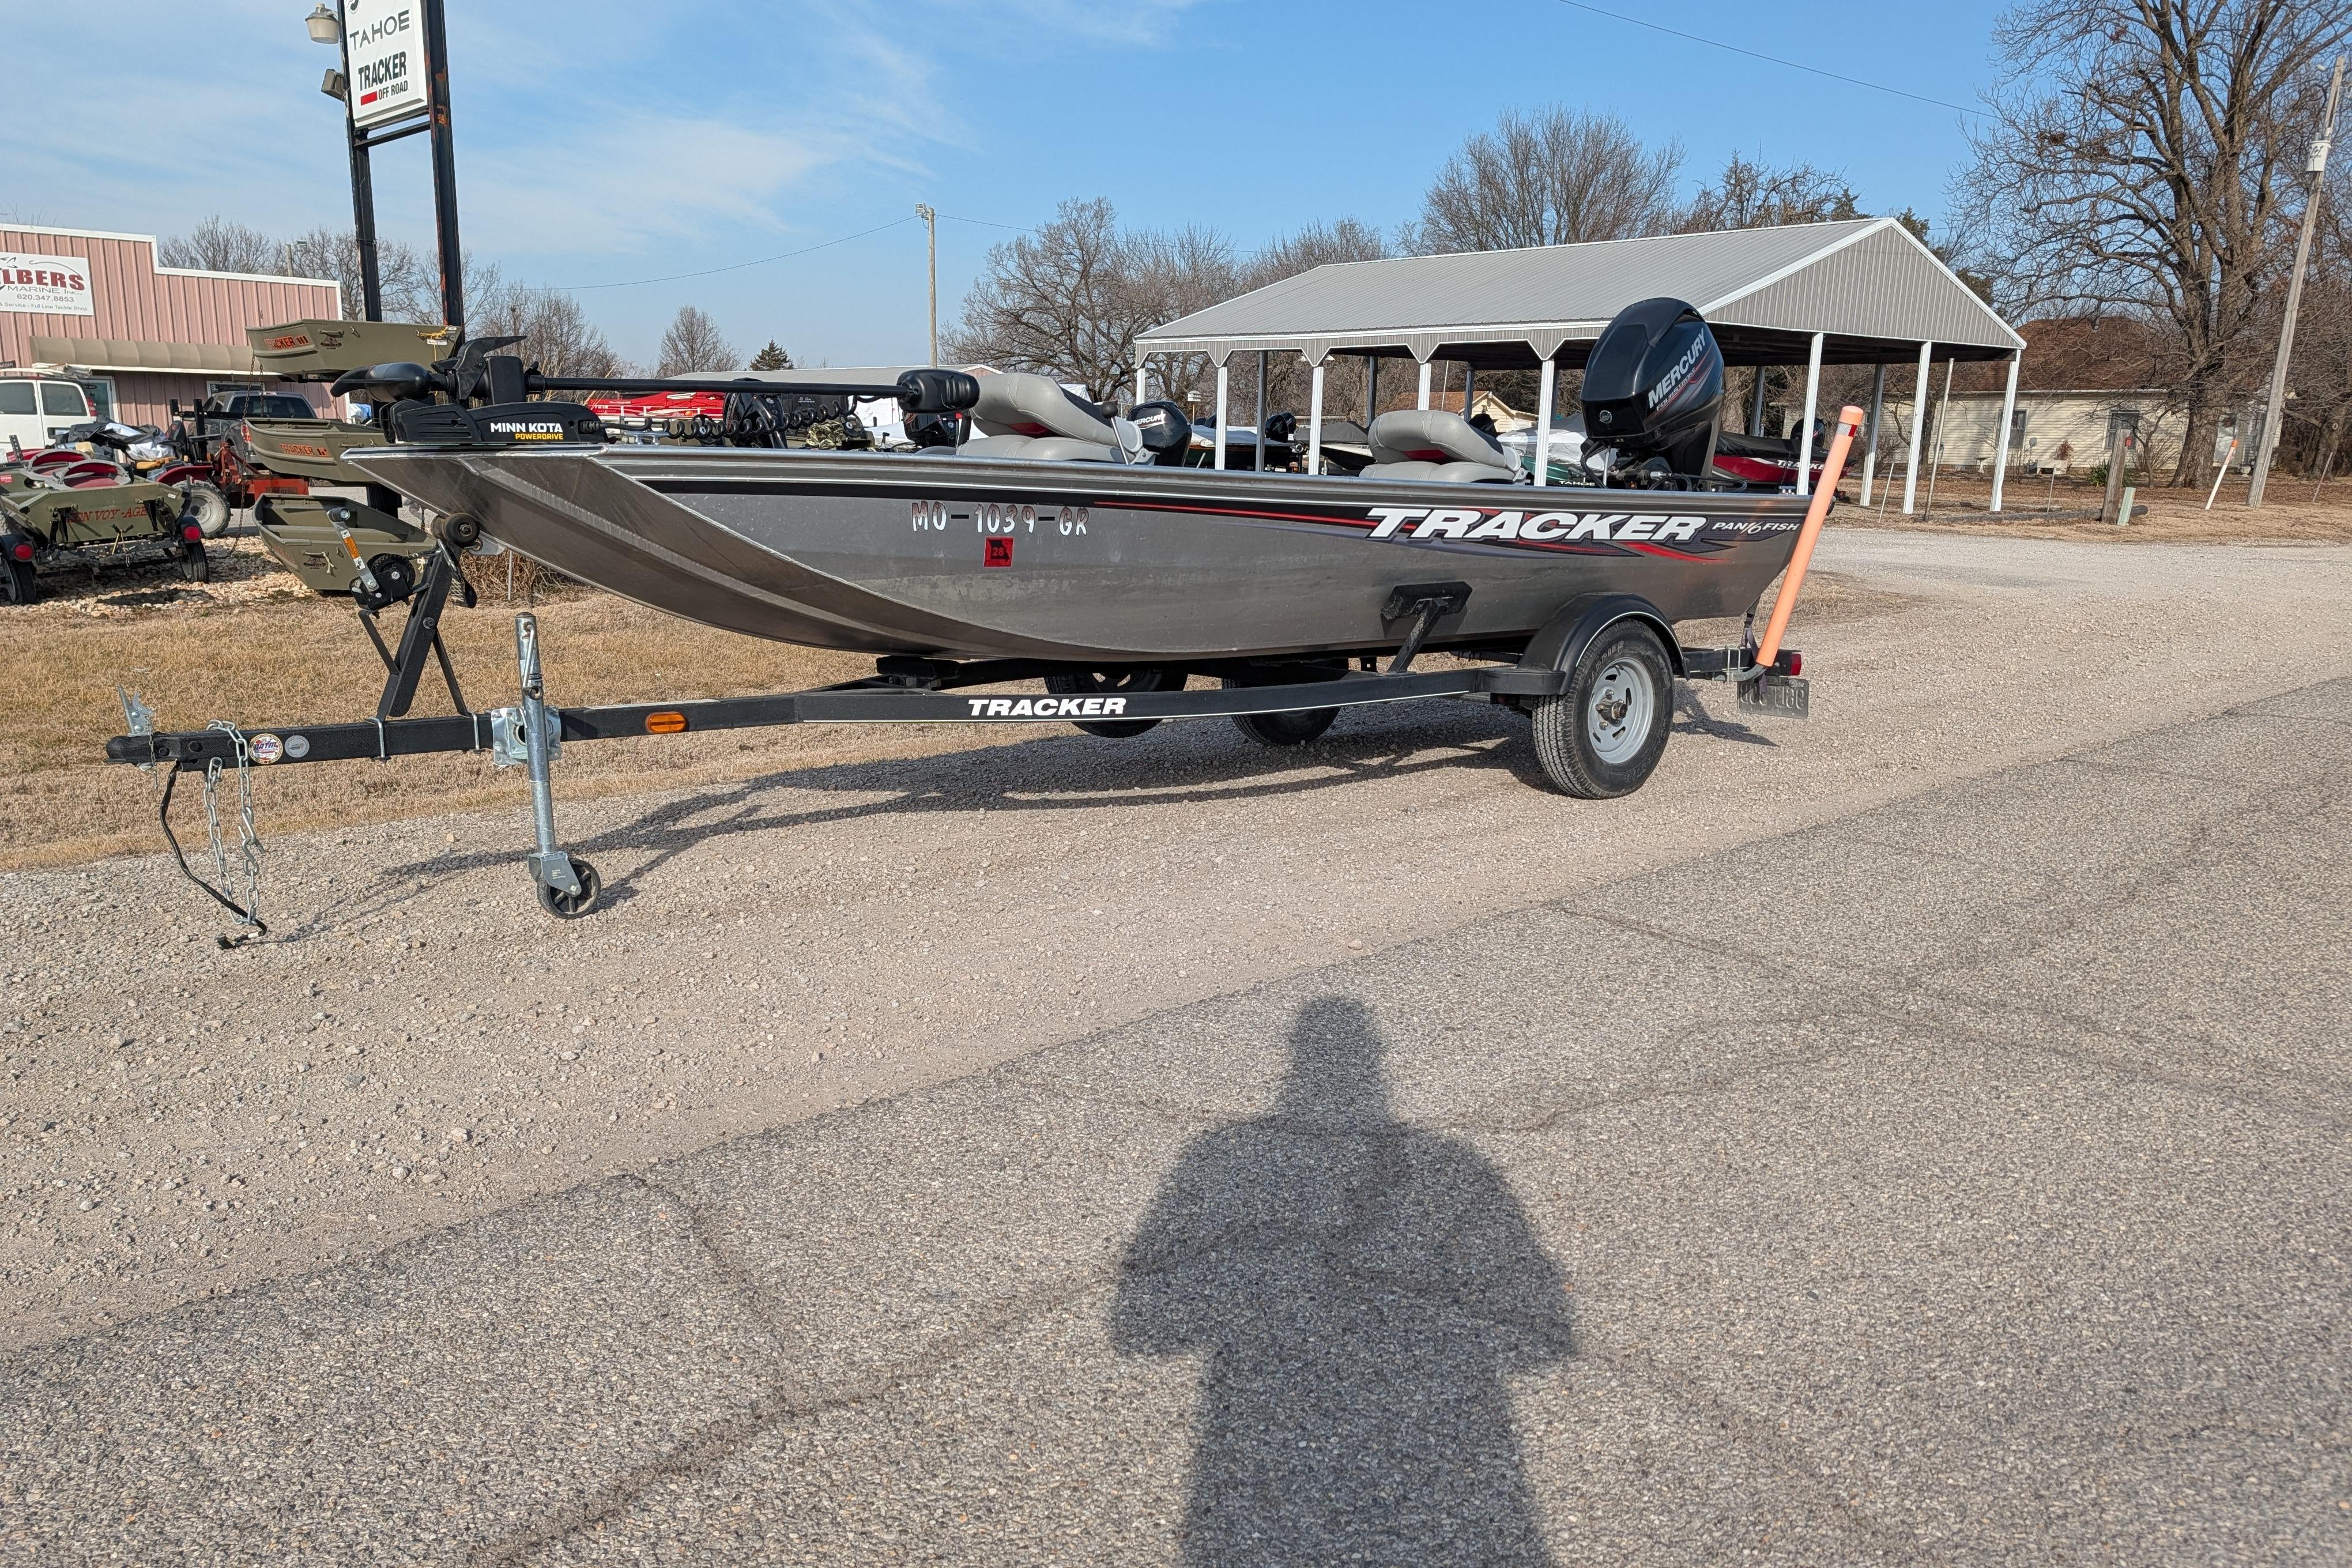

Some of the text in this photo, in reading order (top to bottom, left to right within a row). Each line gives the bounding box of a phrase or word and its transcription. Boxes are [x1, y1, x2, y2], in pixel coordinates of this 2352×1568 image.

[349, 9, 410, 51] TAHOE
[358, 51, 407, 91] TRACKER
[378, 80, 408, 100] OFF ROAD
[0, 269, 85, 291] LBERS
[7, 285, 60, 294] MARINE
[17, 293, 74, 303] 620.347.8853
[265, 337, 296, 349] ACKER
[1648, 327, 1705, 409] MERCURY
[490, 423, 563, 432] MINN KOTA
[1777, 459, 1825, 470] TRAKE
[1365, 507, 1707, 541] TRACKER
[992, 547, 1004, 556] 28
[968, 698, 1126, 716] TRACKER
